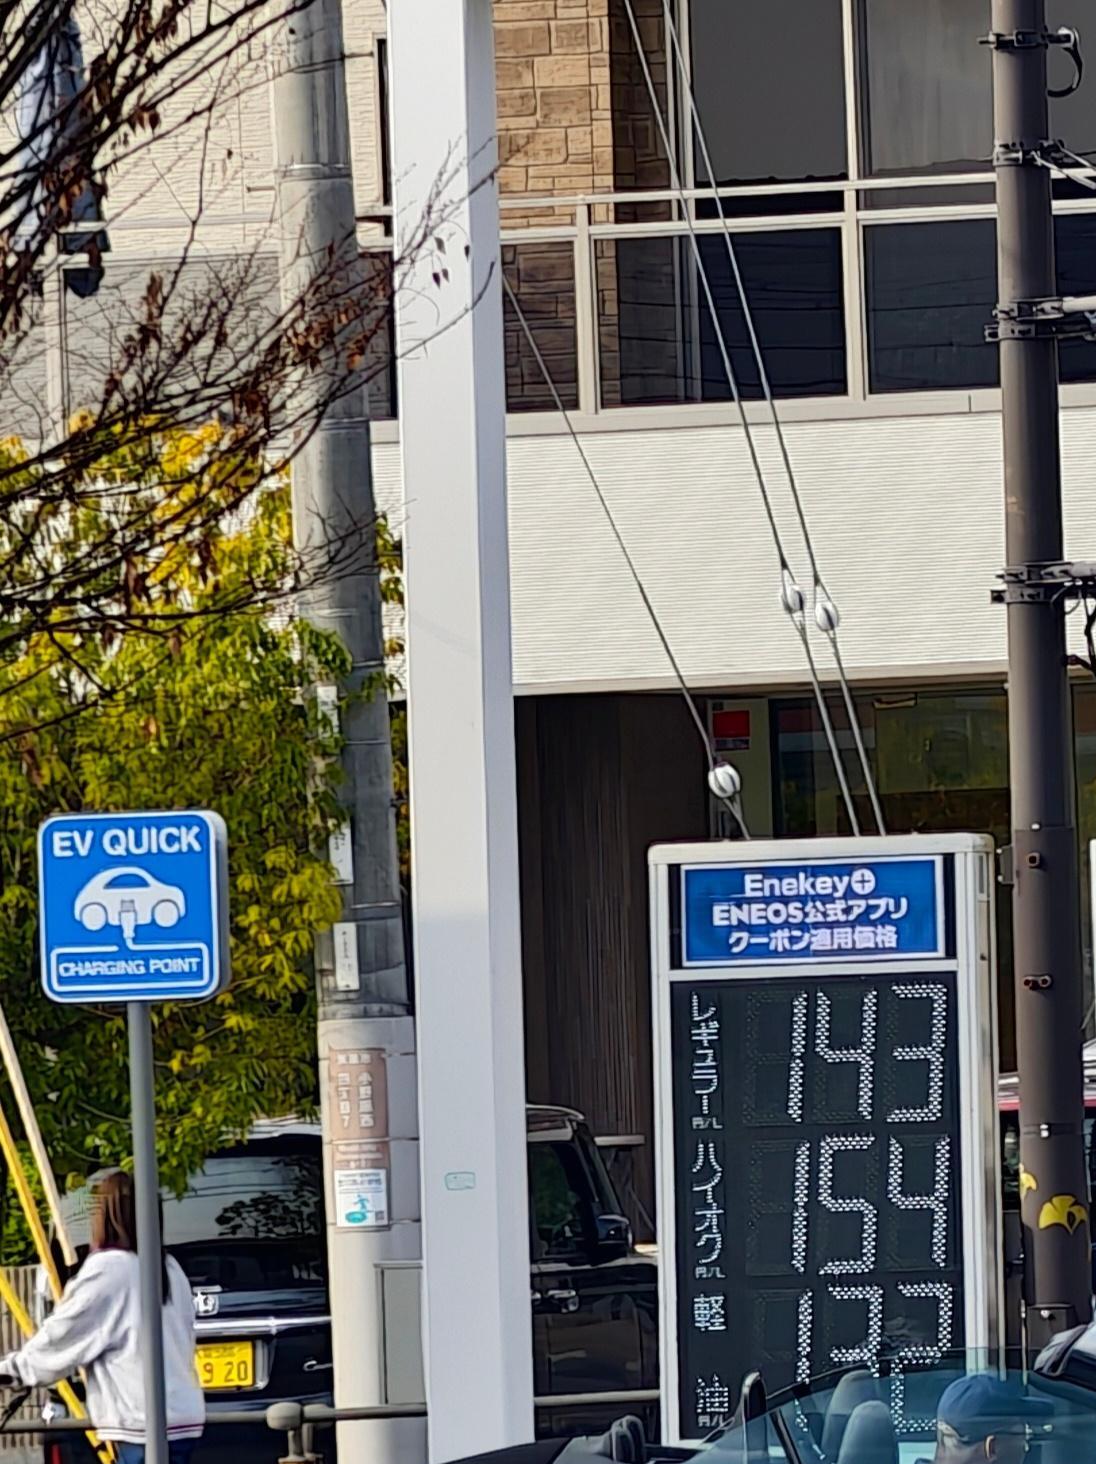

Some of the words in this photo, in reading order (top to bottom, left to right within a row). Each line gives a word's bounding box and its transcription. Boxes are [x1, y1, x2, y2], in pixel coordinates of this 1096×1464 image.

[52, 829, 94, 857] EV
[102, 825, 202, 854] QUICK
[744, 872, 849, 897] Enekey
[712, 897, 908, 926] ENEOS公式アプリ
[728, 925, 898, 953] クーポン適用価格
[58, 960, 146, 977] CHARGING
[149, 958, 200, 974] POINT
[691, 992, 720, 1114] レギュラー
[787, 981, 948, 1123] 143
[692, 1142, 724, 1264] ハイオク
[789, 1132, 951, 1275] 154
